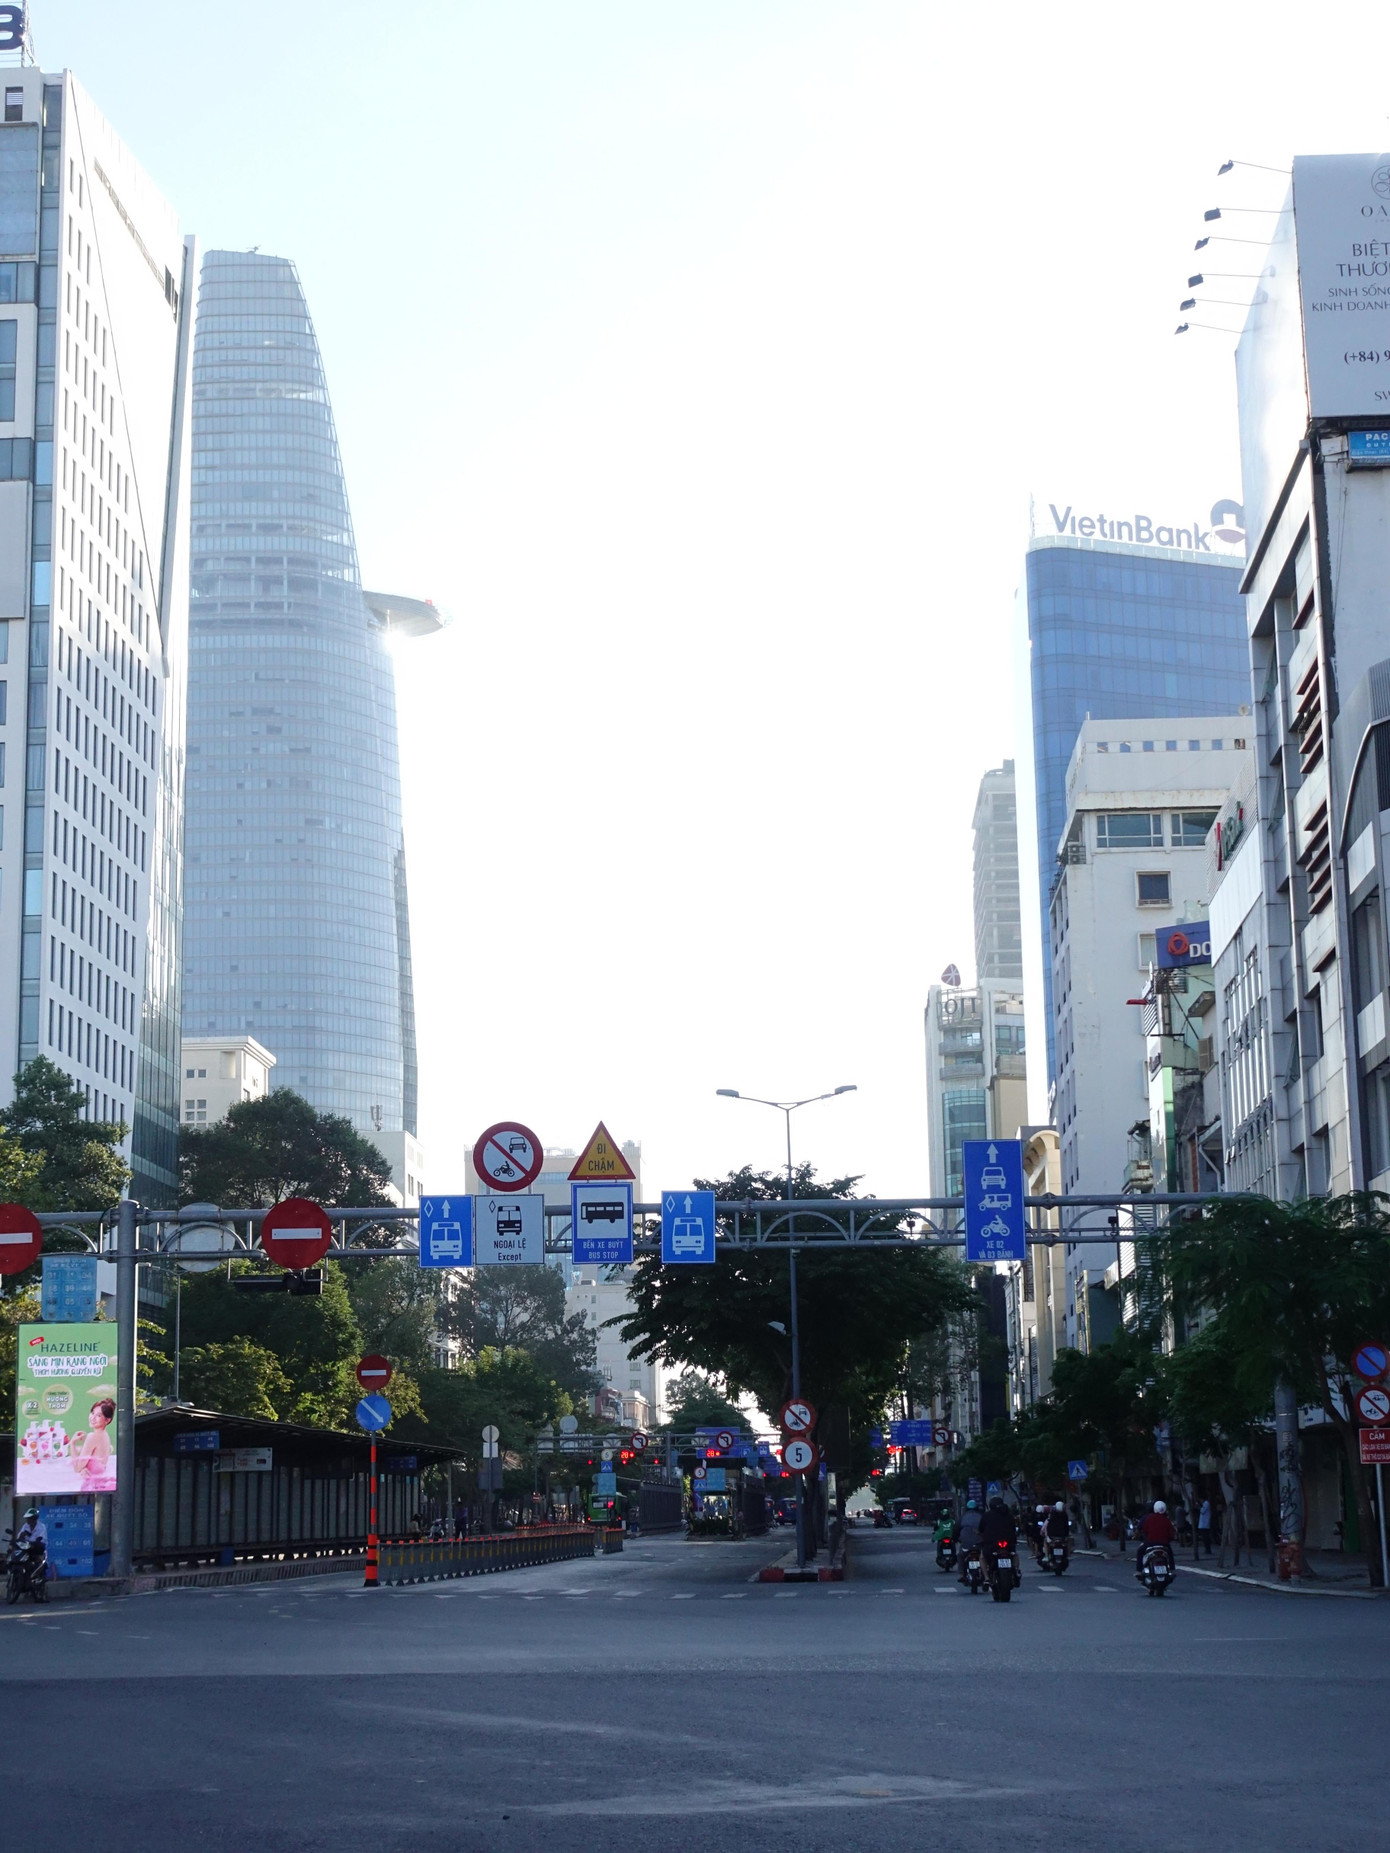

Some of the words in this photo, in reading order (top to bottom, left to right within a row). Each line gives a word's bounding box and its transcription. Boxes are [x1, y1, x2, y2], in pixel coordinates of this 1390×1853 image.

[1352, 239, 1390, 258] BIỆT
[1328, 287, 1358, 298] SINH
[1311, 302, 1343, 312] KINH
[1344, 350, 1380, 366] (+84)
[1049, 503, 1211, 551] VietinBank
[597, 1143, 606, 1154] ĐI
[588, 1158, 615, 1173] CHẬM
[493, 1240, 515, 1250] NGOẠI
[608, 1239, 624, 1249] BUÝT
[498, 1253, 522, 1262] Except
[603, 1251, 619, 1259] STOP
[41, 1342, 99, 1353] HAZELINE
[795, 1447, 802, 1463] 5
